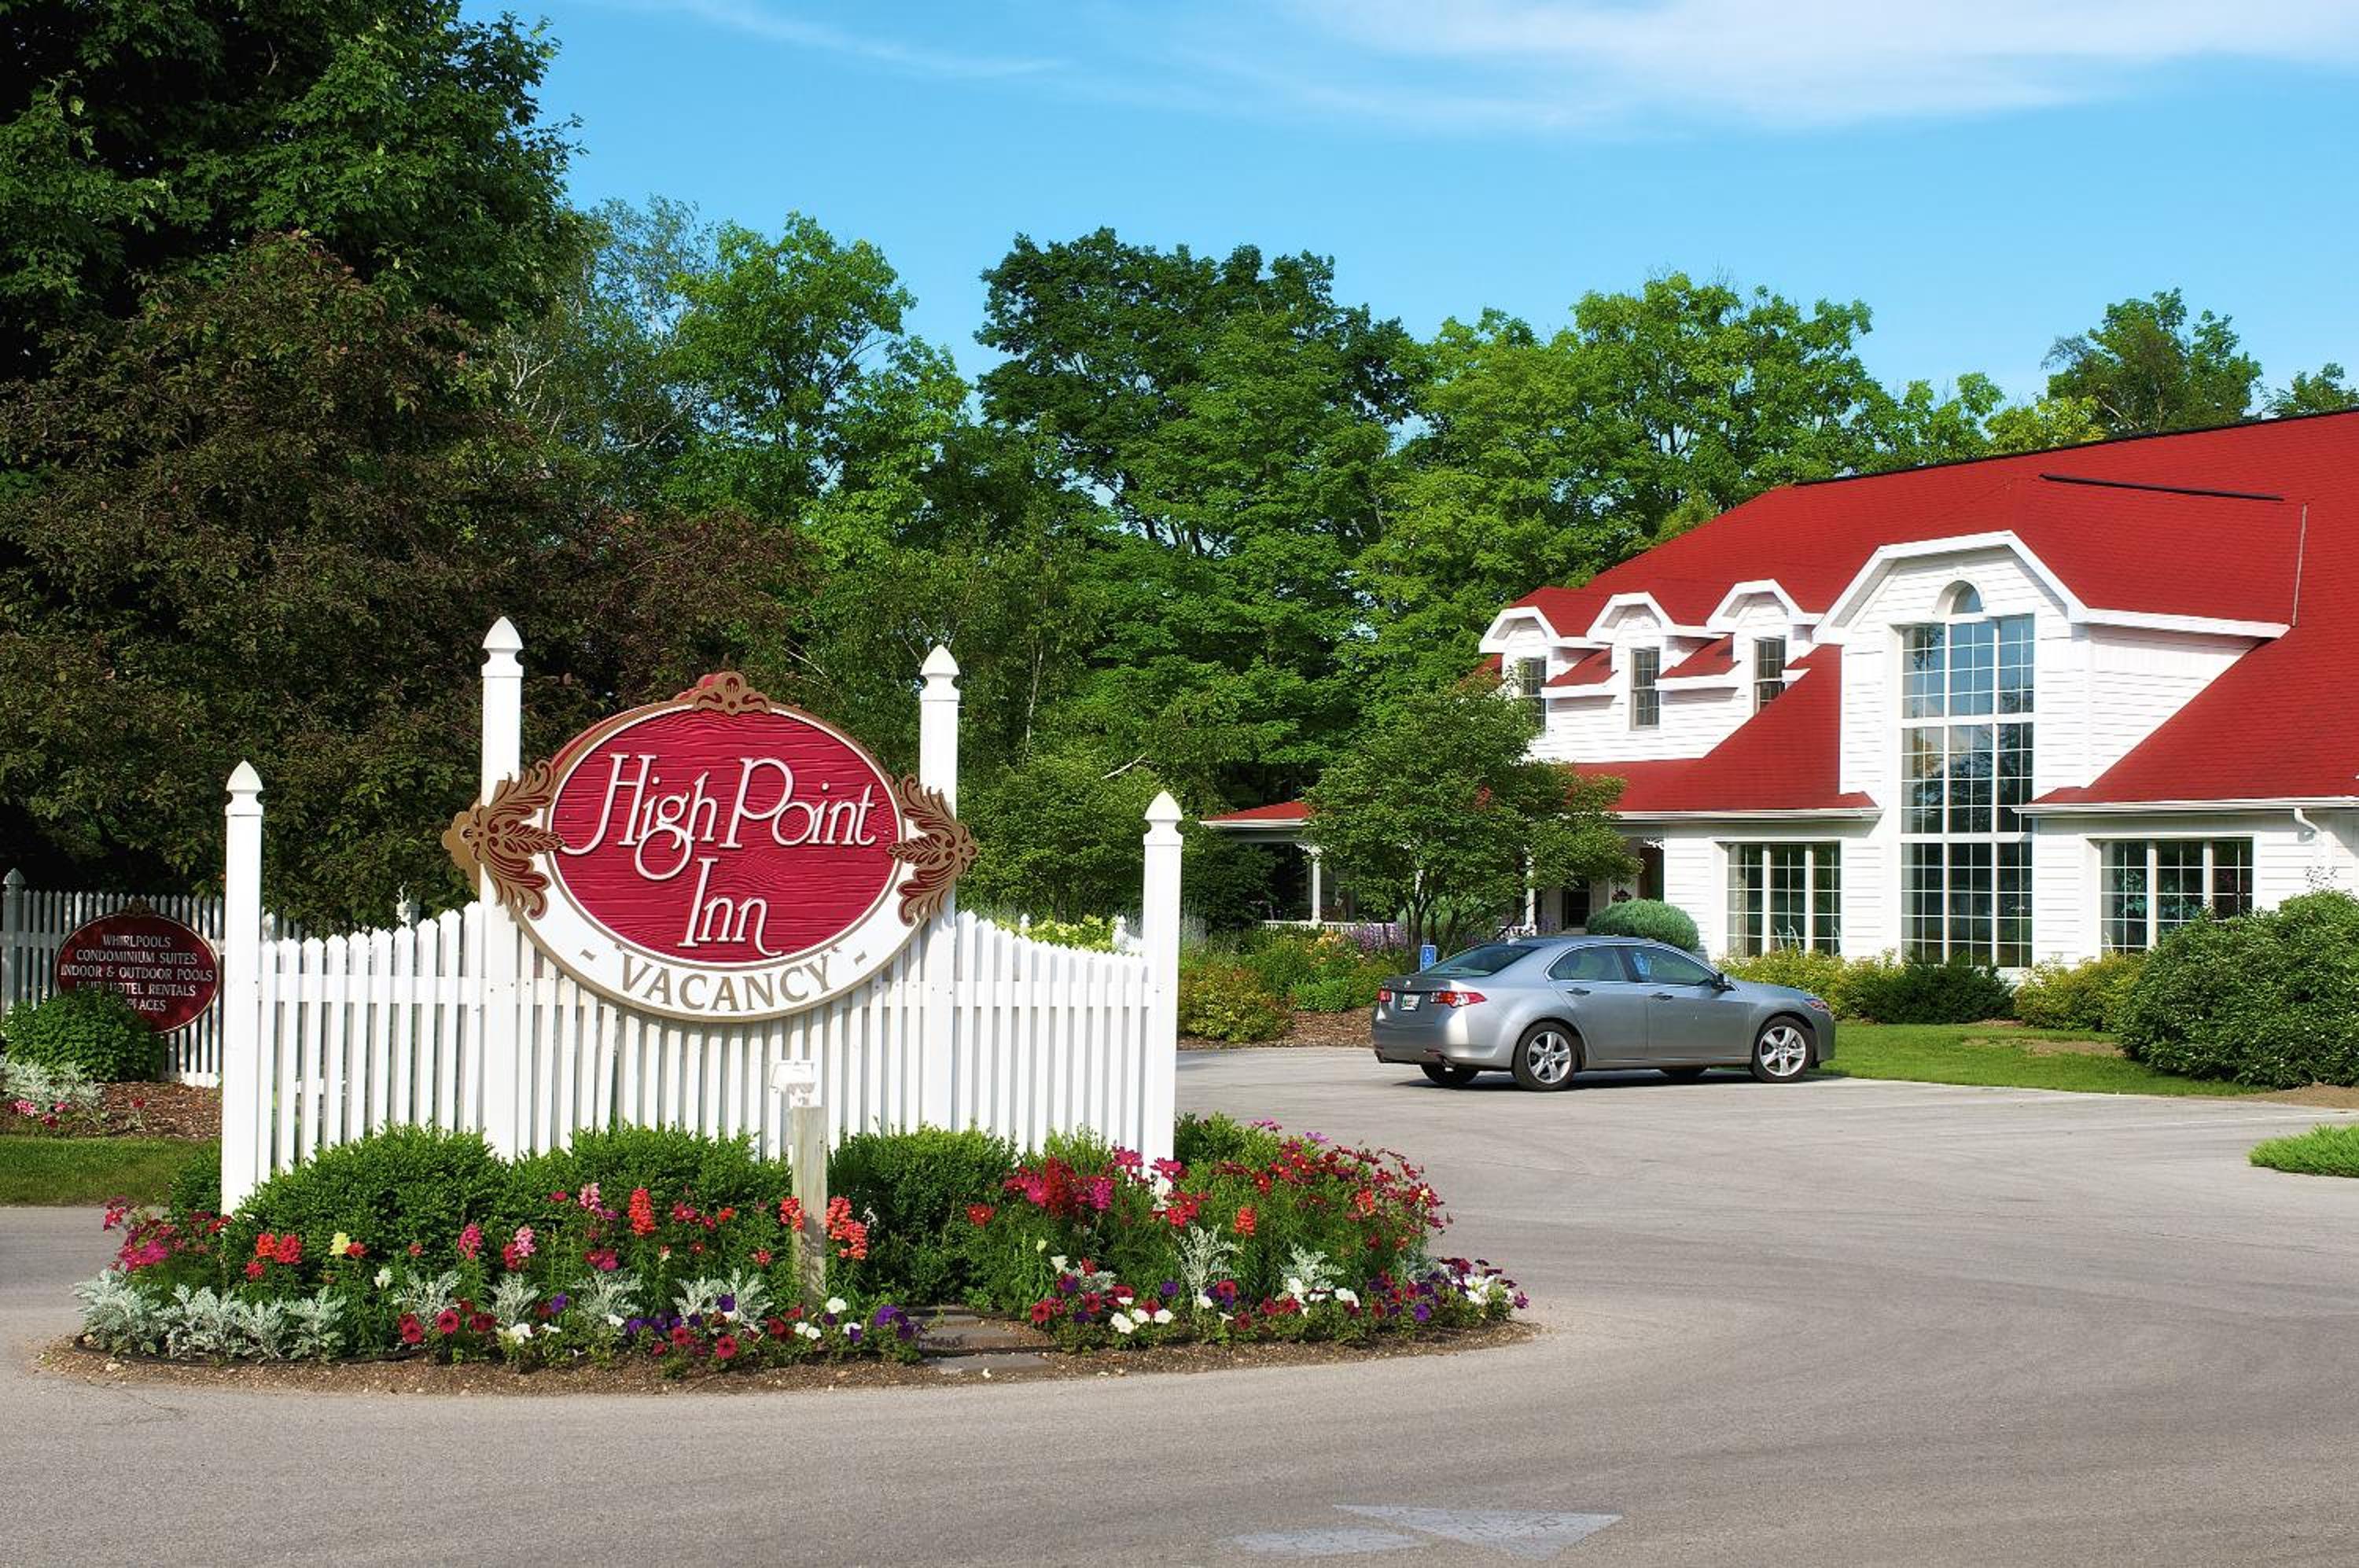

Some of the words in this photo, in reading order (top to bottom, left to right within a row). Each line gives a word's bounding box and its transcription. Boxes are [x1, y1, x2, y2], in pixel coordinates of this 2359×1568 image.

[561, 753, 719, 881] High
[717, 757, 876, 849] Point
[678, 857, 783, 957] Inn
[102, 934, 171, 948] WHIRLPOOLS
[76, 949, 155, 963] CONDOMINIUM
[160, 952, 197, 965] SUITES
[61, 963, 102, 977] INDOOR
[106, 966, 116, 978] &
[119, 966, 172, 981] OUTDOOR
[177, 969, 214, 982] POOLS
[619, 951, 833, 1012] VACANCY
[149, 984, 197, 997] RENTALS
